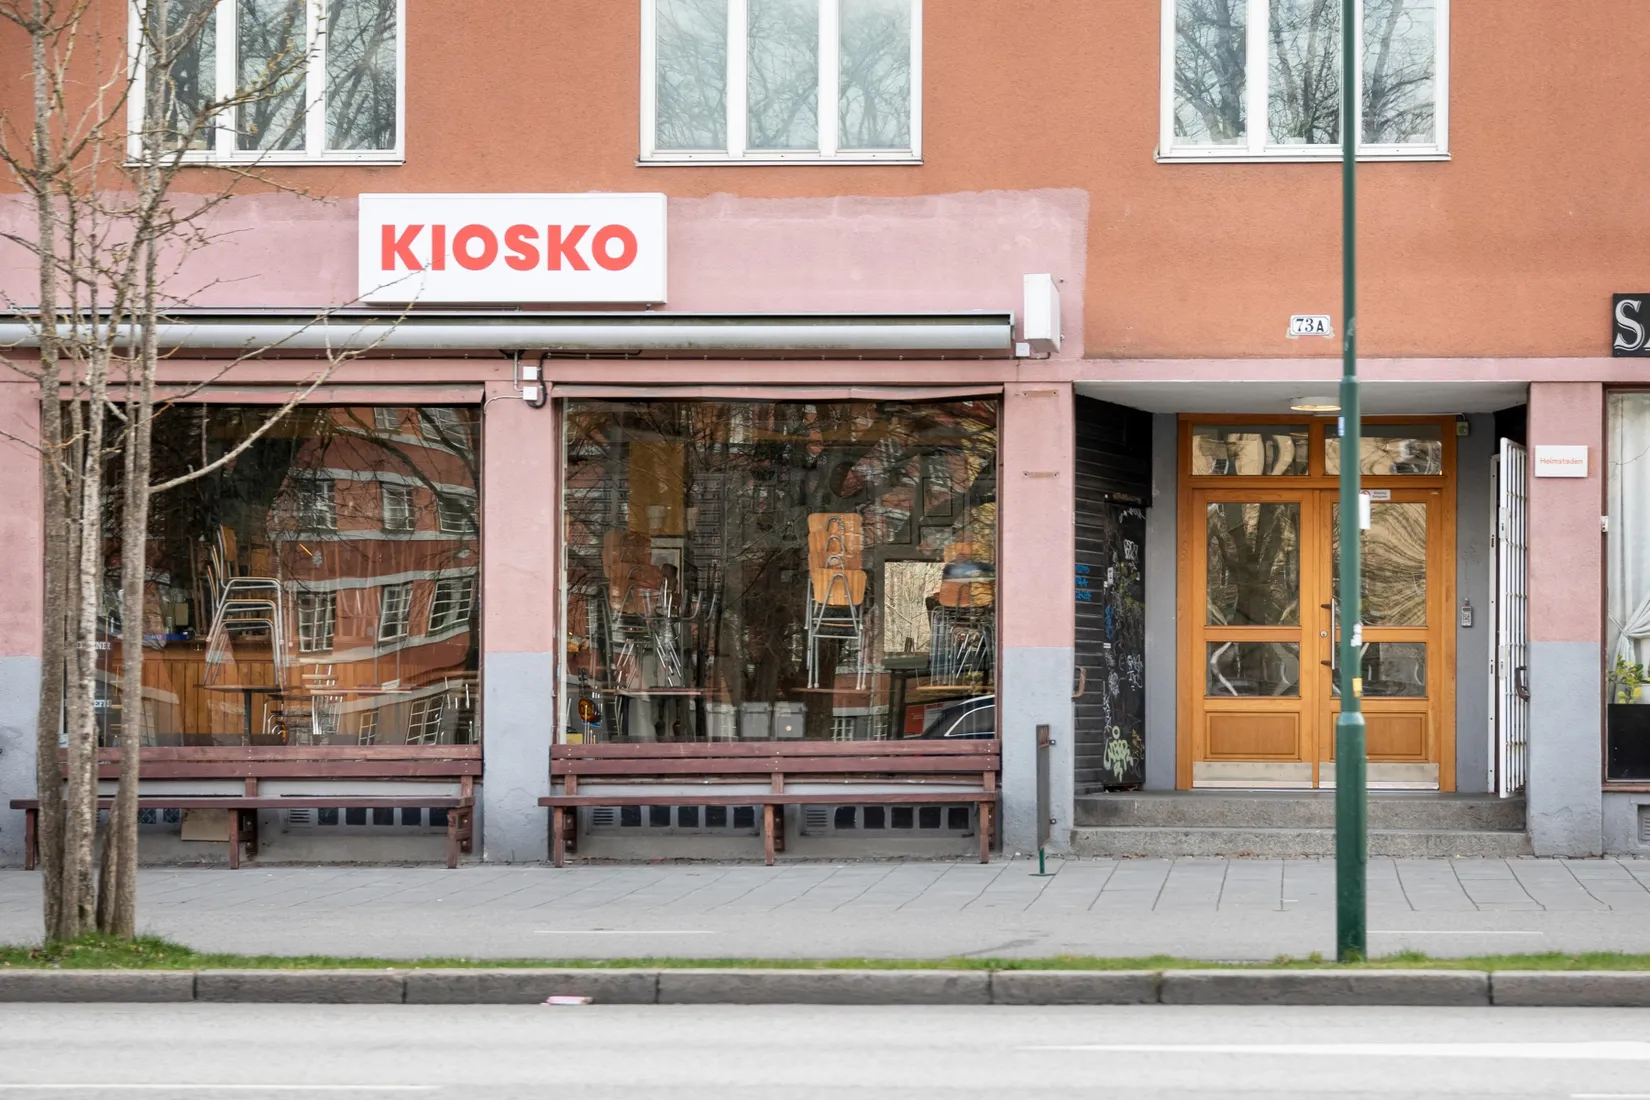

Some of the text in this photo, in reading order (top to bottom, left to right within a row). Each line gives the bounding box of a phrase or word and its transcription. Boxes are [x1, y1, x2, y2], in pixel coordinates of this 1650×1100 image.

[381, 223, 638, 272] KIOSKO
[1614, 299, 1650, 351] S
[1540, 457, 1583, 465] Heimstaden
